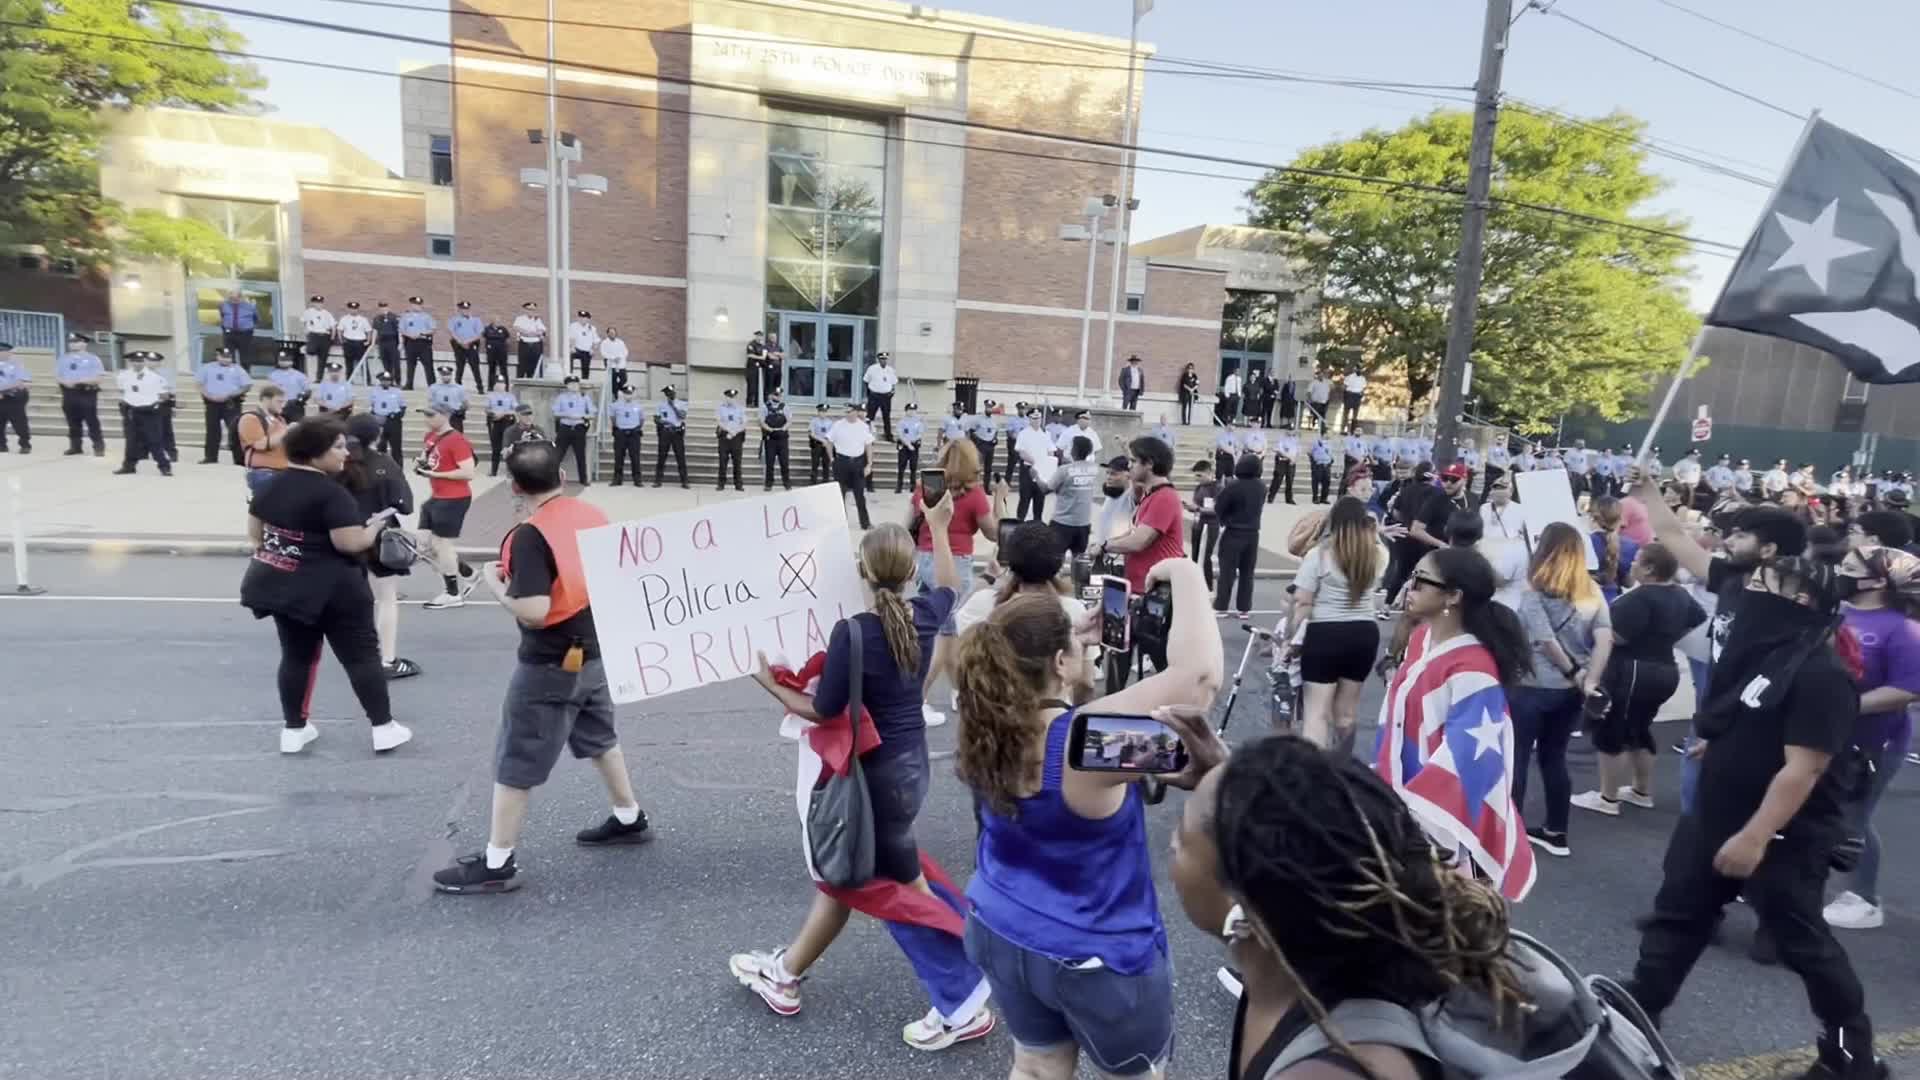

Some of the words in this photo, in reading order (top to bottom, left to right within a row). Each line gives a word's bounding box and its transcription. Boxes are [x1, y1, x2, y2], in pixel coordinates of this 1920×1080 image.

[618, 526, 663, 568] NO
[638, 567, 760, 631] Policia
[634, 602, 844, 696] BRUTA
